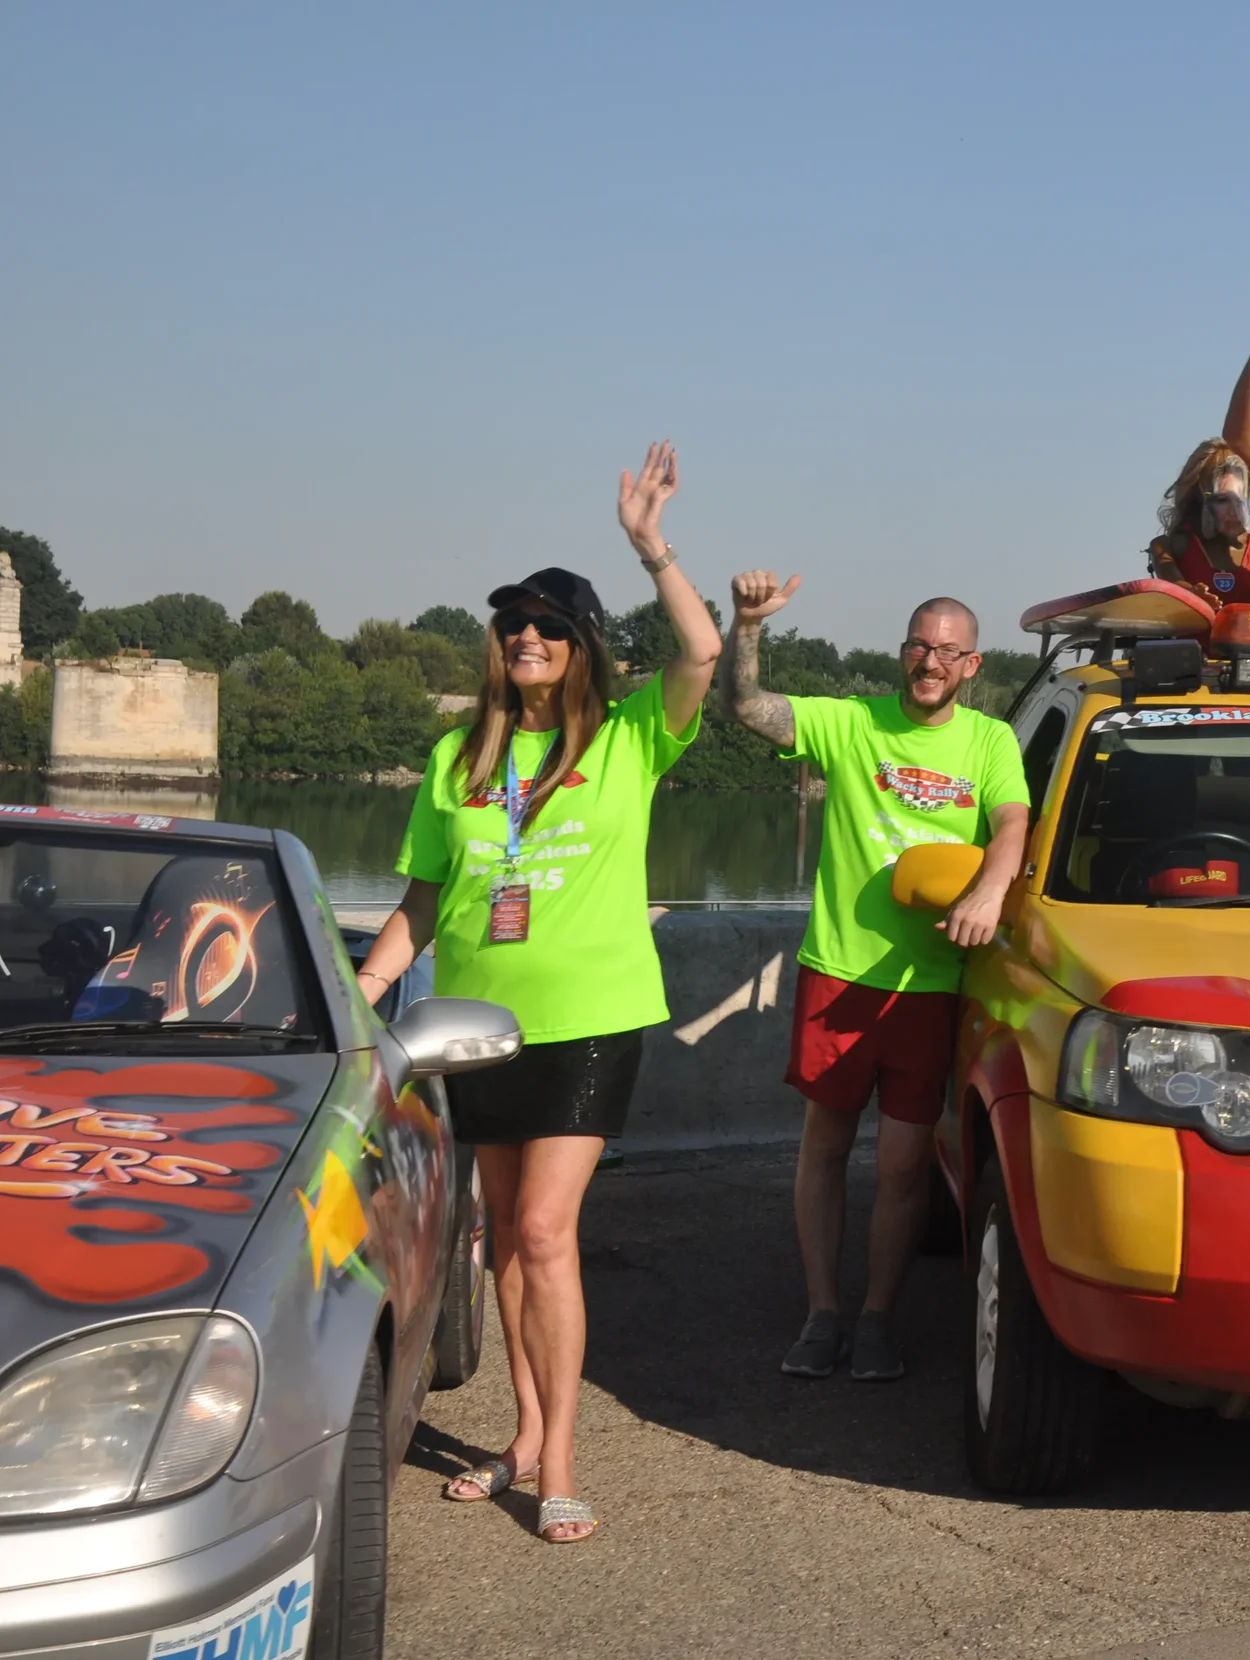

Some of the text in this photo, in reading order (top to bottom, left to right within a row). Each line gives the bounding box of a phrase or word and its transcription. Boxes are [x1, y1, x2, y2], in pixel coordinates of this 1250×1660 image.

[1219, 580, 1230, 588] 23
[886, 774, 960, 799] Wacky Rally
